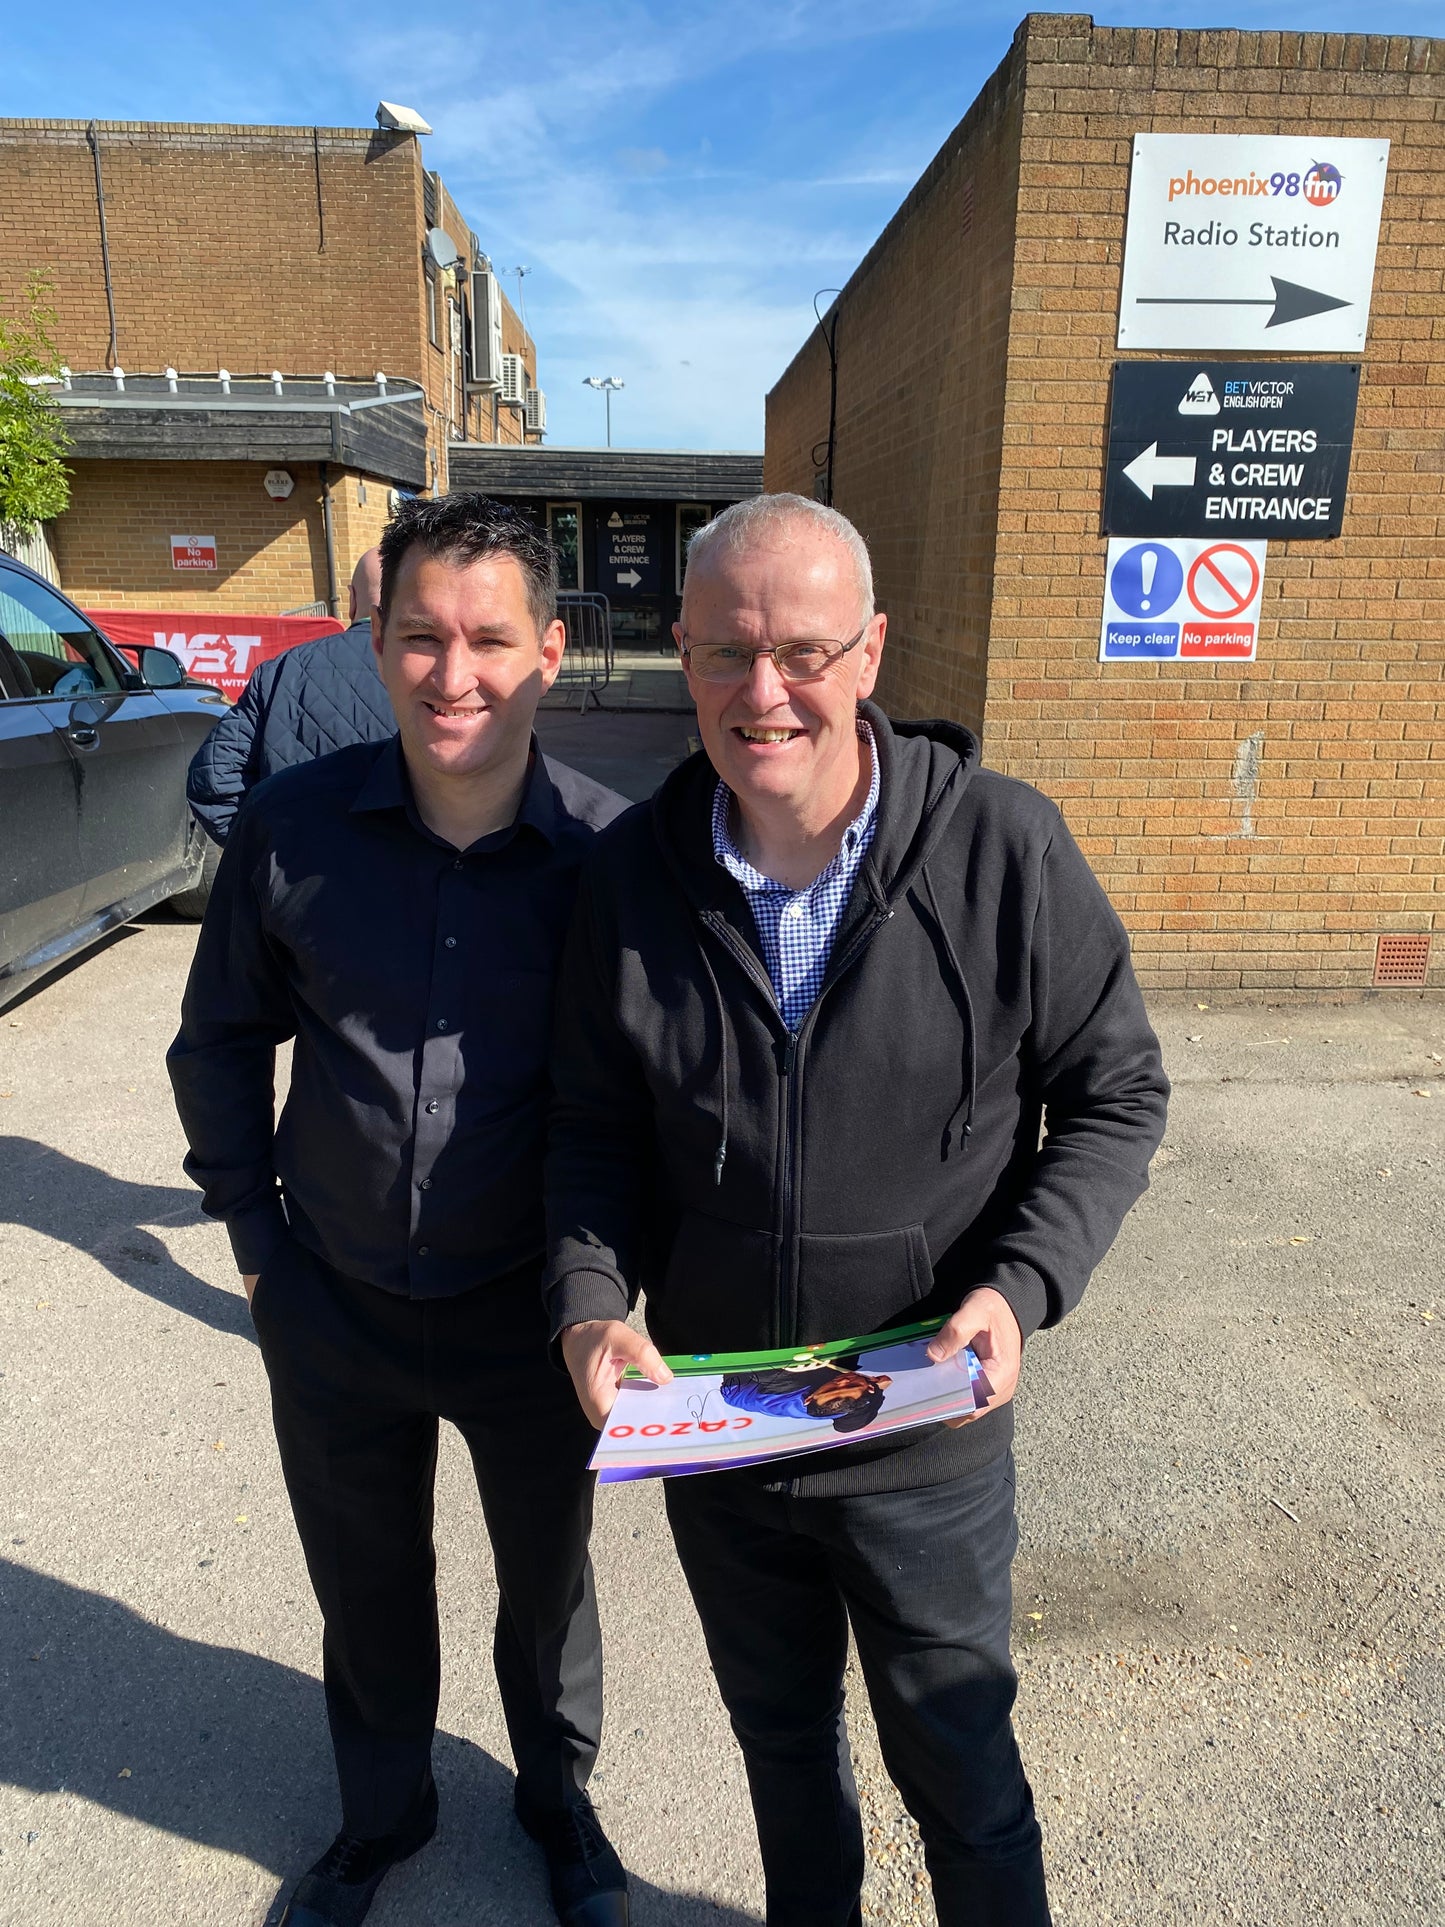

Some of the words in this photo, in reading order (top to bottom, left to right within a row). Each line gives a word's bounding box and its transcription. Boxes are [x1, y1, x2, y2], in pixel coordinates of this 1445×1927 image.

[1164, 221, 1238, 246] Radio
[1248, 222, 1340, 248] Station
[1224, 381, 1294, 394] BETVICTOR
[1186, 391, 1213, 403] WST
[1223, 396, 1259, 408] ENGLISH
[1260, 396, 1283, 408] OPEN
[1211, 429, 1317, 453] PLAYERS
[1208, 464, 1225, 486] &
[1231, 464, 1304, 486] CREW
[1205, 497, 1331, 520] ENTRANCE
[187, 547, 201, 556] No
[614, 545, 621, 553] &
[621, 545, 644, 553] CREW
[177, 558, 213, 569] parking
[609, 556, 649, 564] ENTRANCE
[1108, 633, 1141, 646] Keep
[1144, 633, 1175, 644] clear
[1183, 633, 1201, 644] No
[1204, 633, 1251, 647] parking
[608, 1417, 753, 1438] CAZOO
